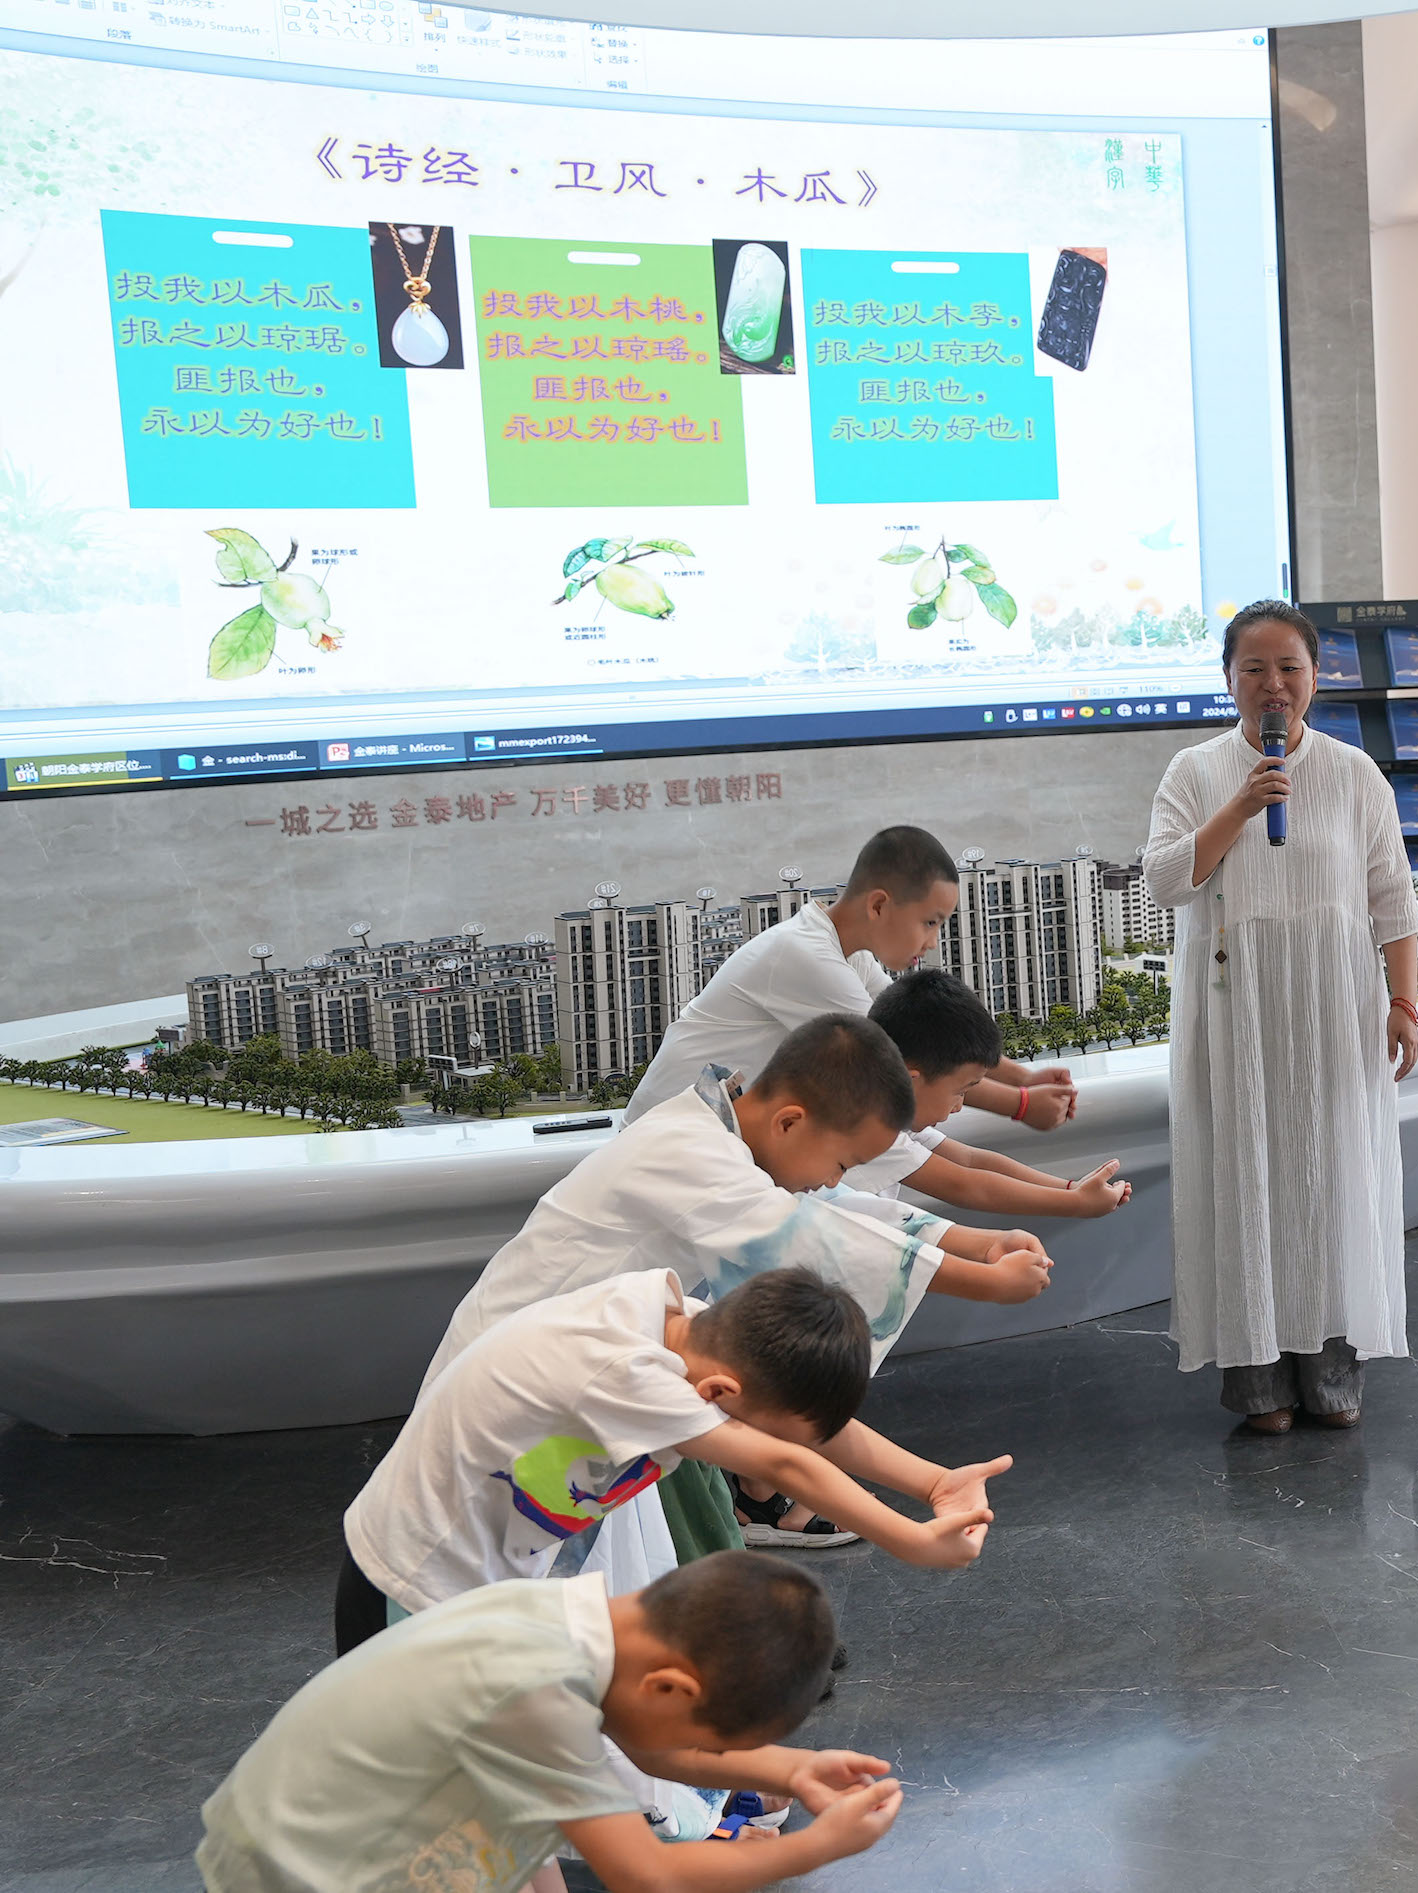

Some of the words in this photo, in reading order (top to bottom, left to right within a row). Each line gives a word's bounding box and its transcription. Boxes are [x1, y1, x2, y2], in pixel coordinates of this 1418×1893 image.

[209, 21, 261, 35] SmartArt
[424, 32, 446, 43] 排列
[116, 272, 362, 312] 投我以木瓜，
[484, 291, 704, 322] 投我以木桃，
[814, 300, 1020, 328] 投我以木李，
[120, 317, 366, 354] 报之以琼琚。
[488, 333, 707, 363] 报之以琼瑶。
[816, 340, 1023, 365] 报之以琼玖。
[176, 367, 324, 396] 匪报也，
[535, 376, 668, 402] 匪报也，
[860, 379, 985, 403] 匪报也，
[202, 755, 215, 767] 金
[410, 742, 455, 753] Micros...
[245, 800, 379, 837] 一城之选
[389, 790, 518, 829] 金泰地产
[530, 782, 652, 817] 万千美好
[663, 772, 783, 808] 更懂朝阳
